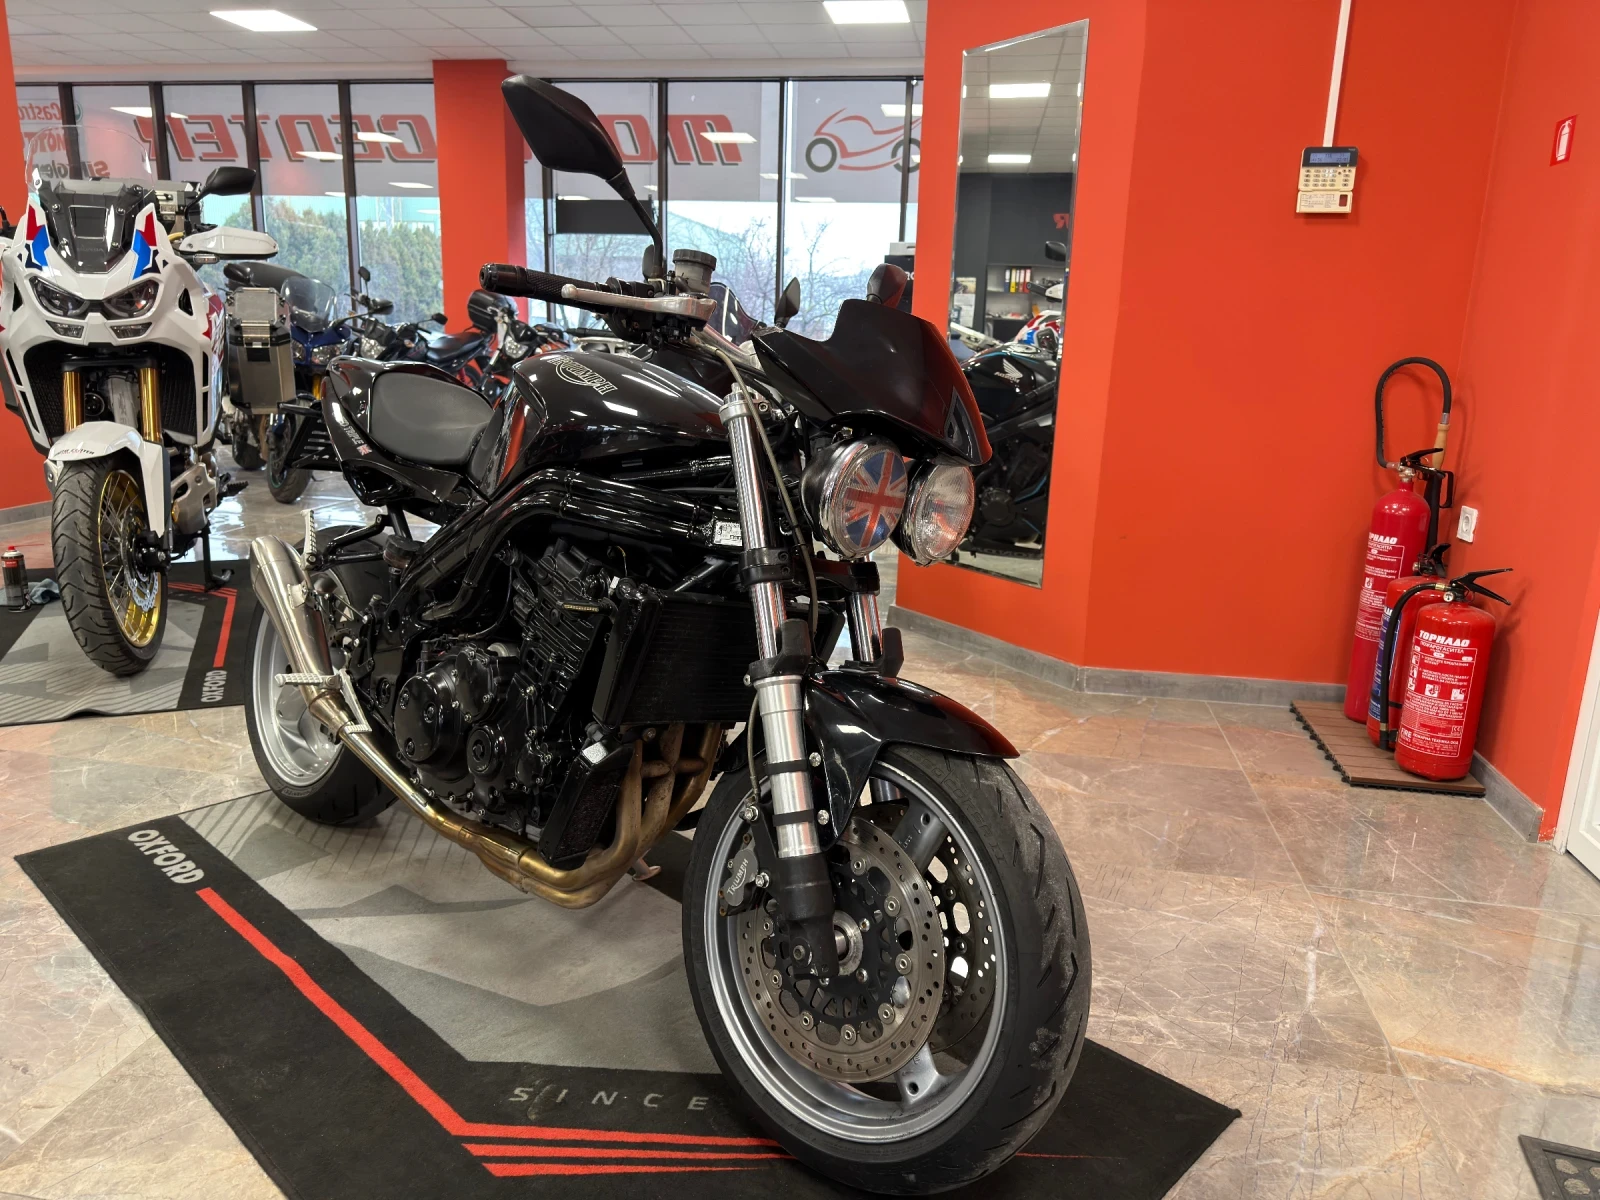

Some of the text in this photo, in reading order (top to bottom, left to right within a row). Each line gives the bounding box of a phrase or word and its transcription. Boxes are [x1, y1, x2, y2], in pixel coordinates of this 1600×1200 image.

[546, 355, 618, 395] TRIUMPH
[1419, 629, 1470, 648] ТОРНАДО
[200, 670, 228, 703] OXFORD
[127, 829, 205, 884] OXFORD
[727, 858, 749, 895] TRIUMPH
[508, 1087, 709, 1111] SINCE
